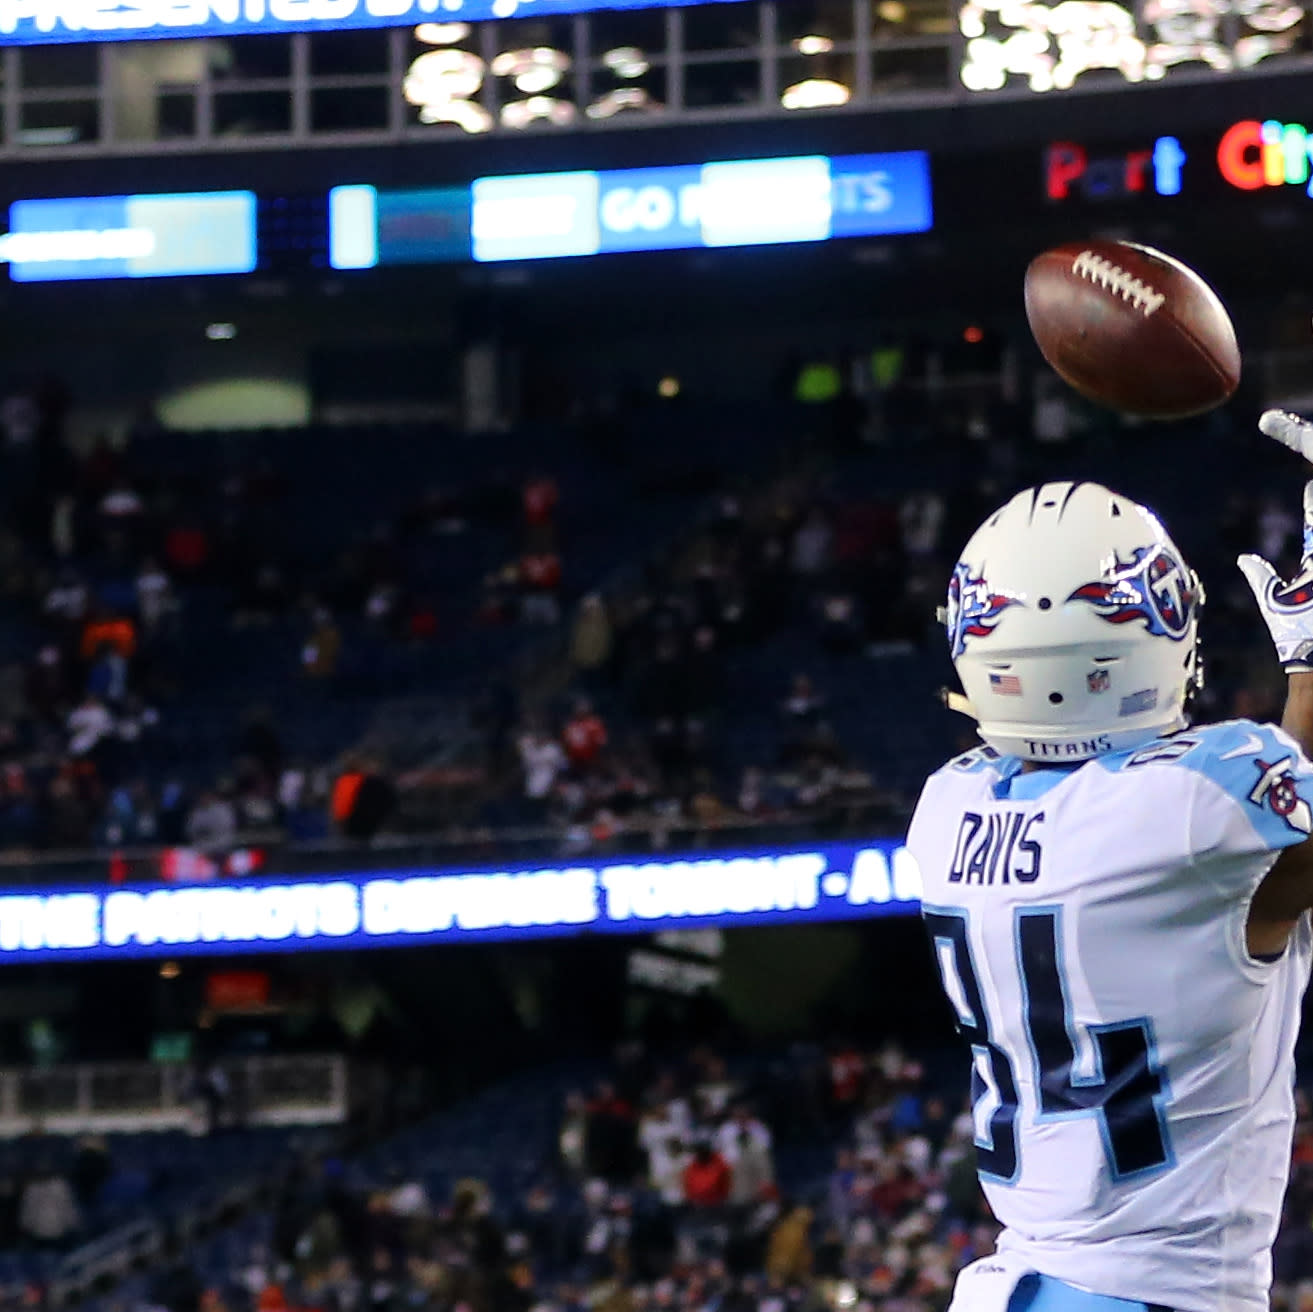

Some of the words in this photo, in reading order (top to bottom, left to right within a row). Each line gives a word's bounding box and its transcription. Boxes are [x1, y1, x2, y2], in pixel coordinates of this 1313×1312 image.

[603, 186, 674, 231] GO
[1024, 733, 1113, 757] TITANS
[947, 810, 1045, 885] DAVIS
[922, 903, 1178, 1187] 84
